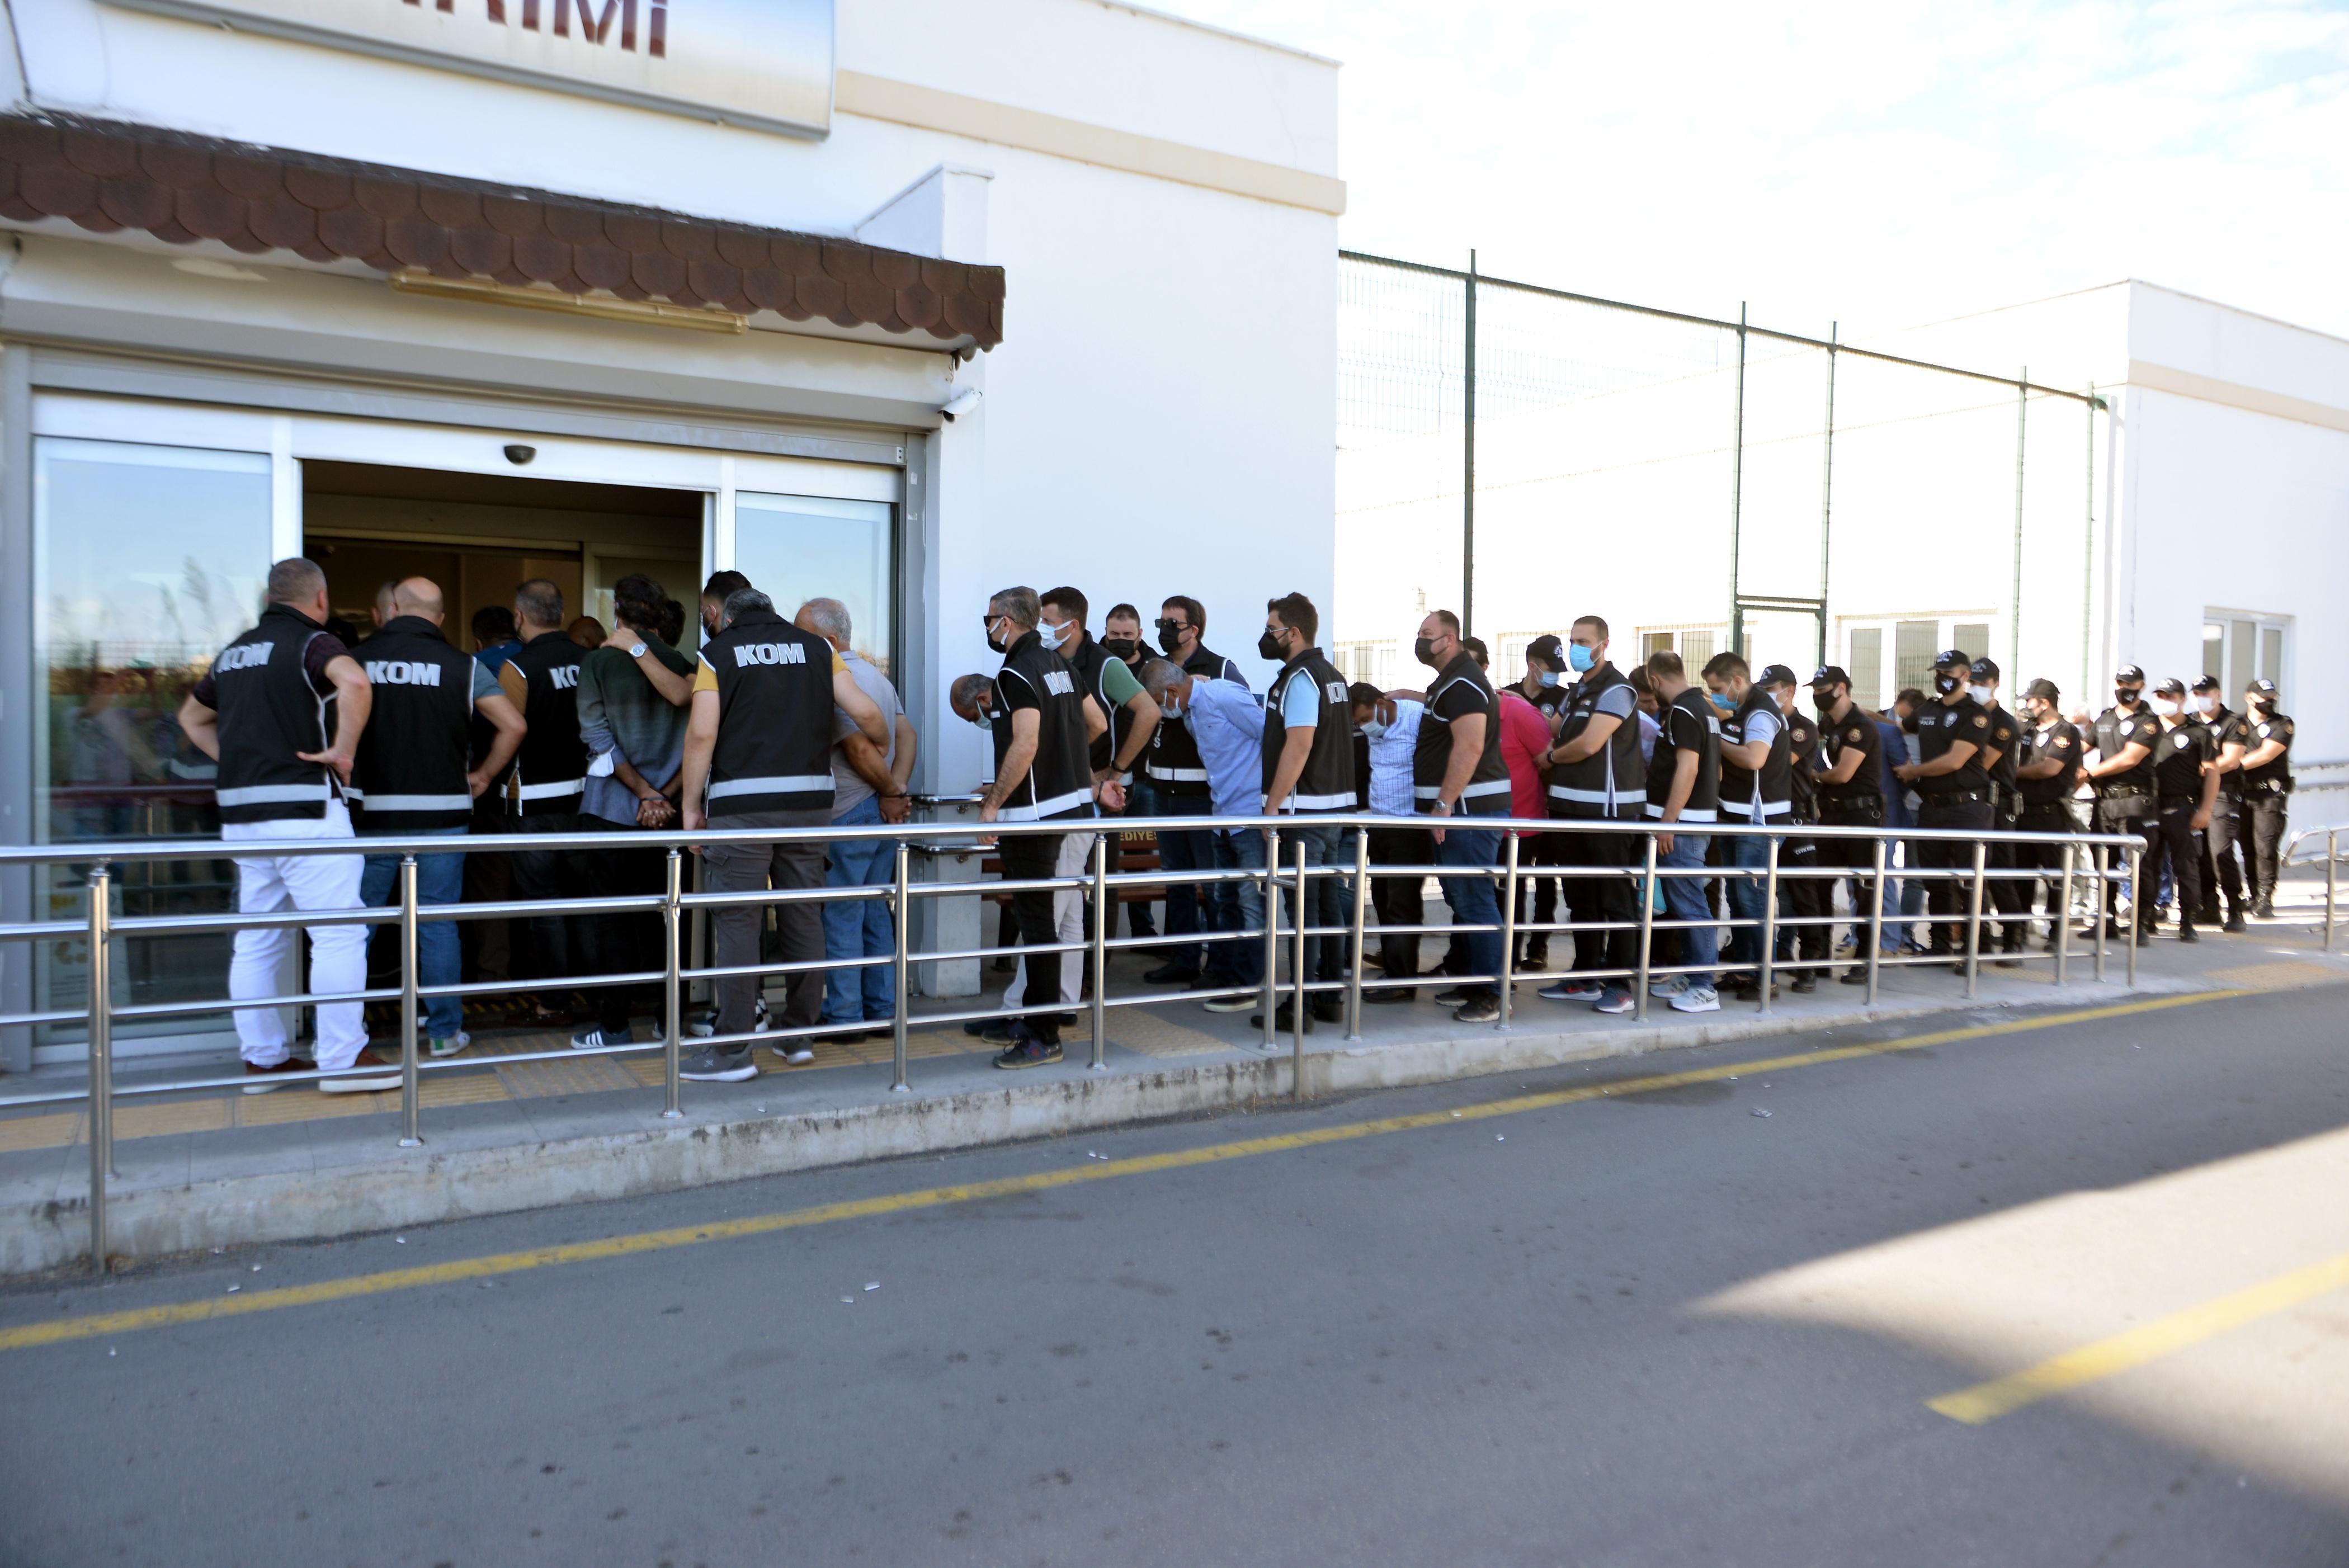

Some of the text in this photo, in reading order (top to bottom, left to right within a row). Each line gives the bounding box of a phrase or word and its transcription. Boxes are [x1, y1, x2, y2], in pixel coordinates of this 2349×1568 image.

[216, 641, 275, 673] KOM
[733, 643, 806, 668] KOM
[365, 660, 441, 687] KOM
[549, 665, 581, 690] KO
